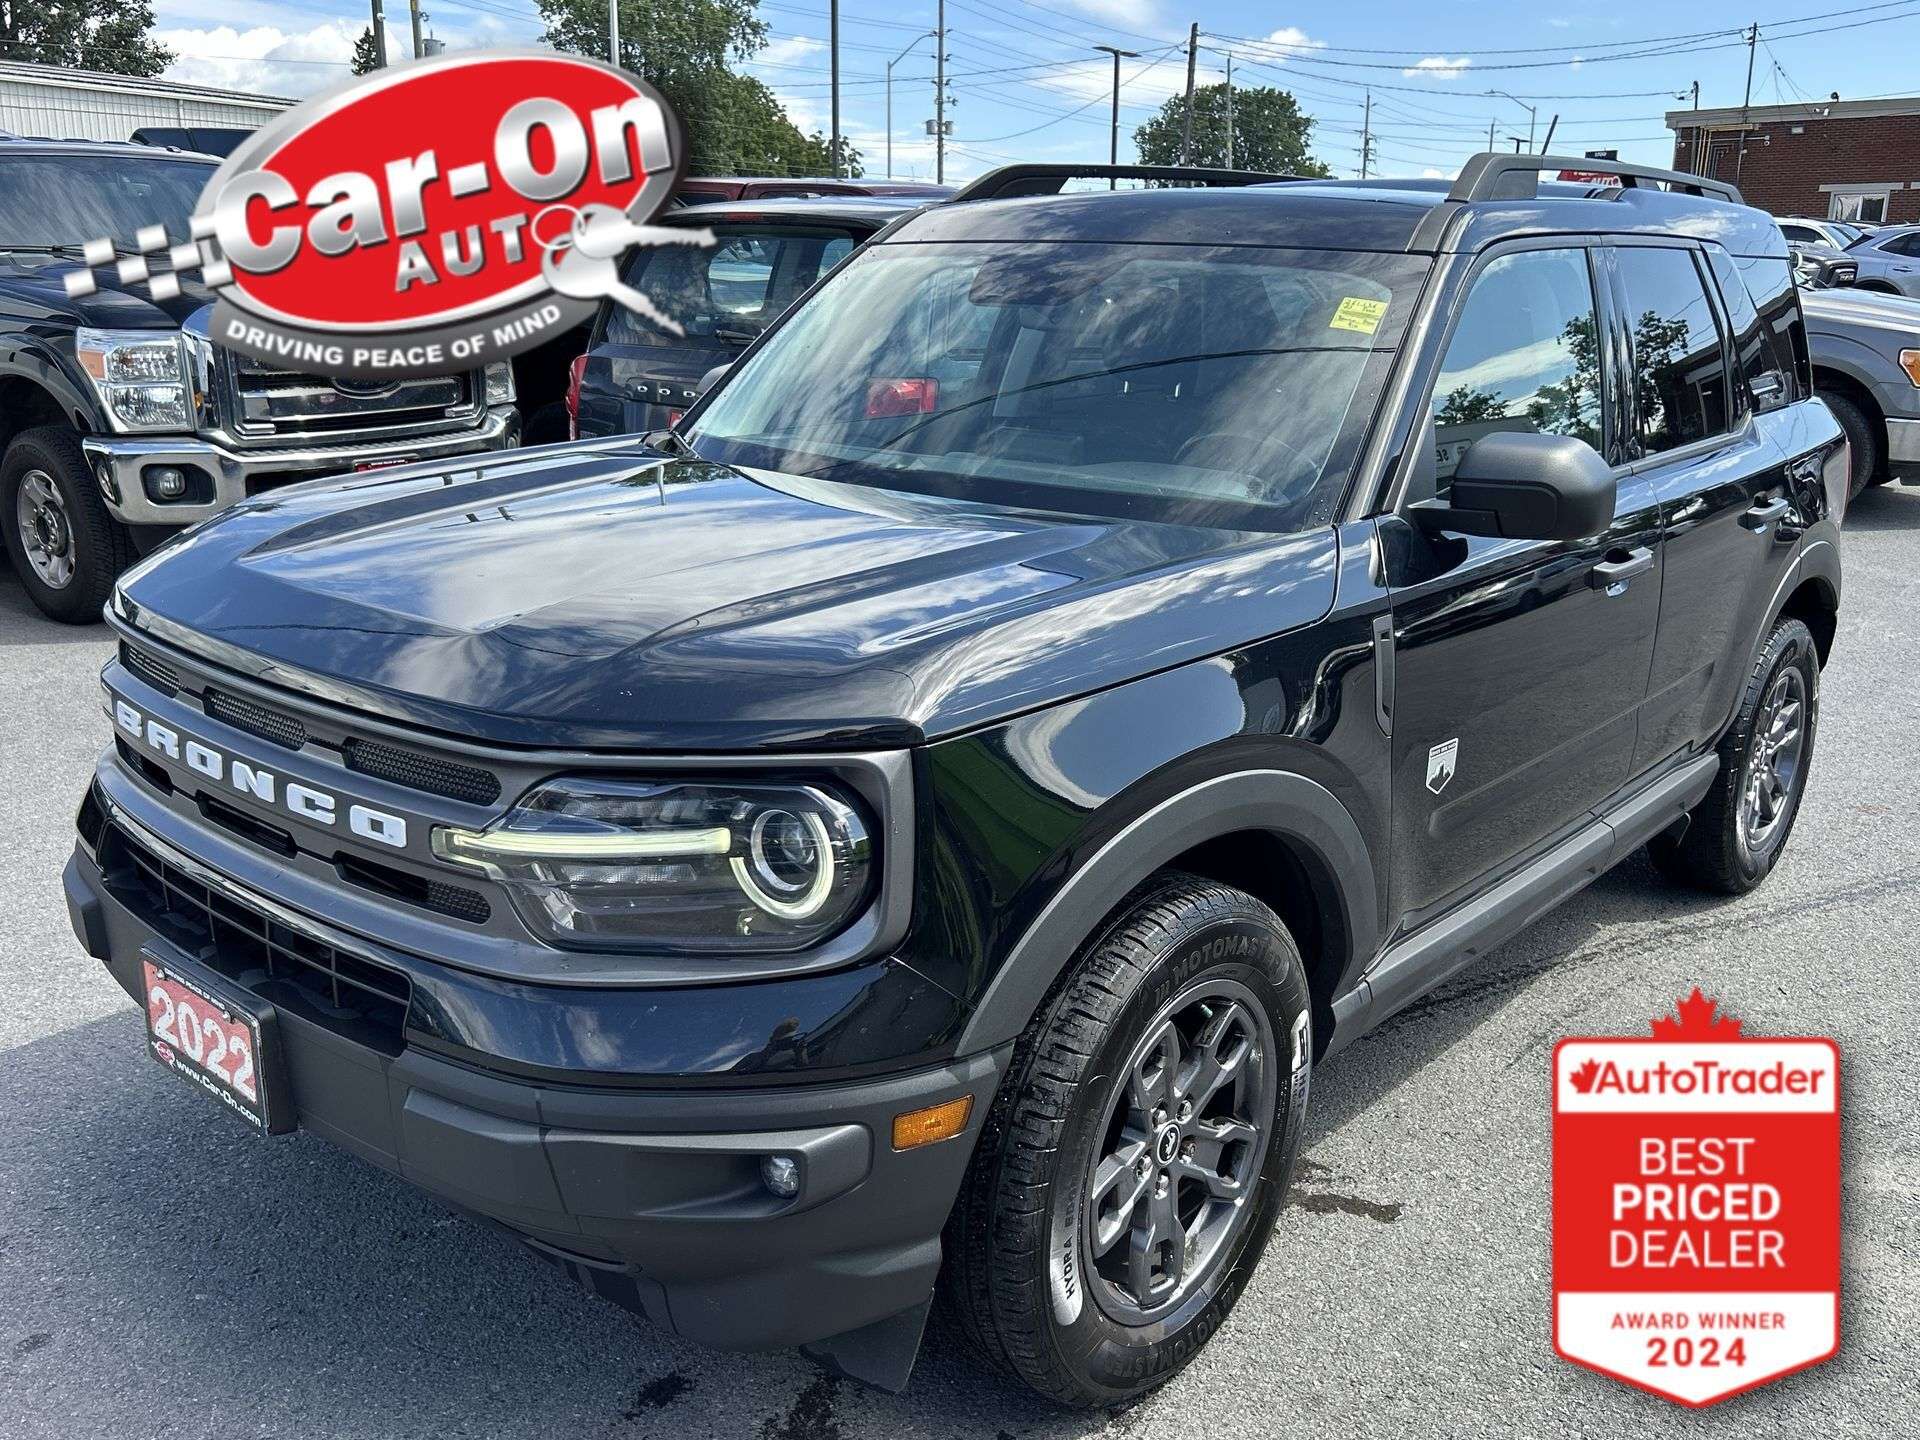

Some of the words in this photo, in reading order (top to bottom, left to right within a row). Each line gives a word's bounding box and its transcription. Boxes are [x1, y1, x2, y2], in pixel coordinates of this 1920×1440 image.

[117, 700, 407, 848] BRONCO
[150, 986, 257, 1102] 2022
[176, 1060, 261, 1127] www.Car-On.com
[1062, 1235, 1074, 1300] HYDRA
